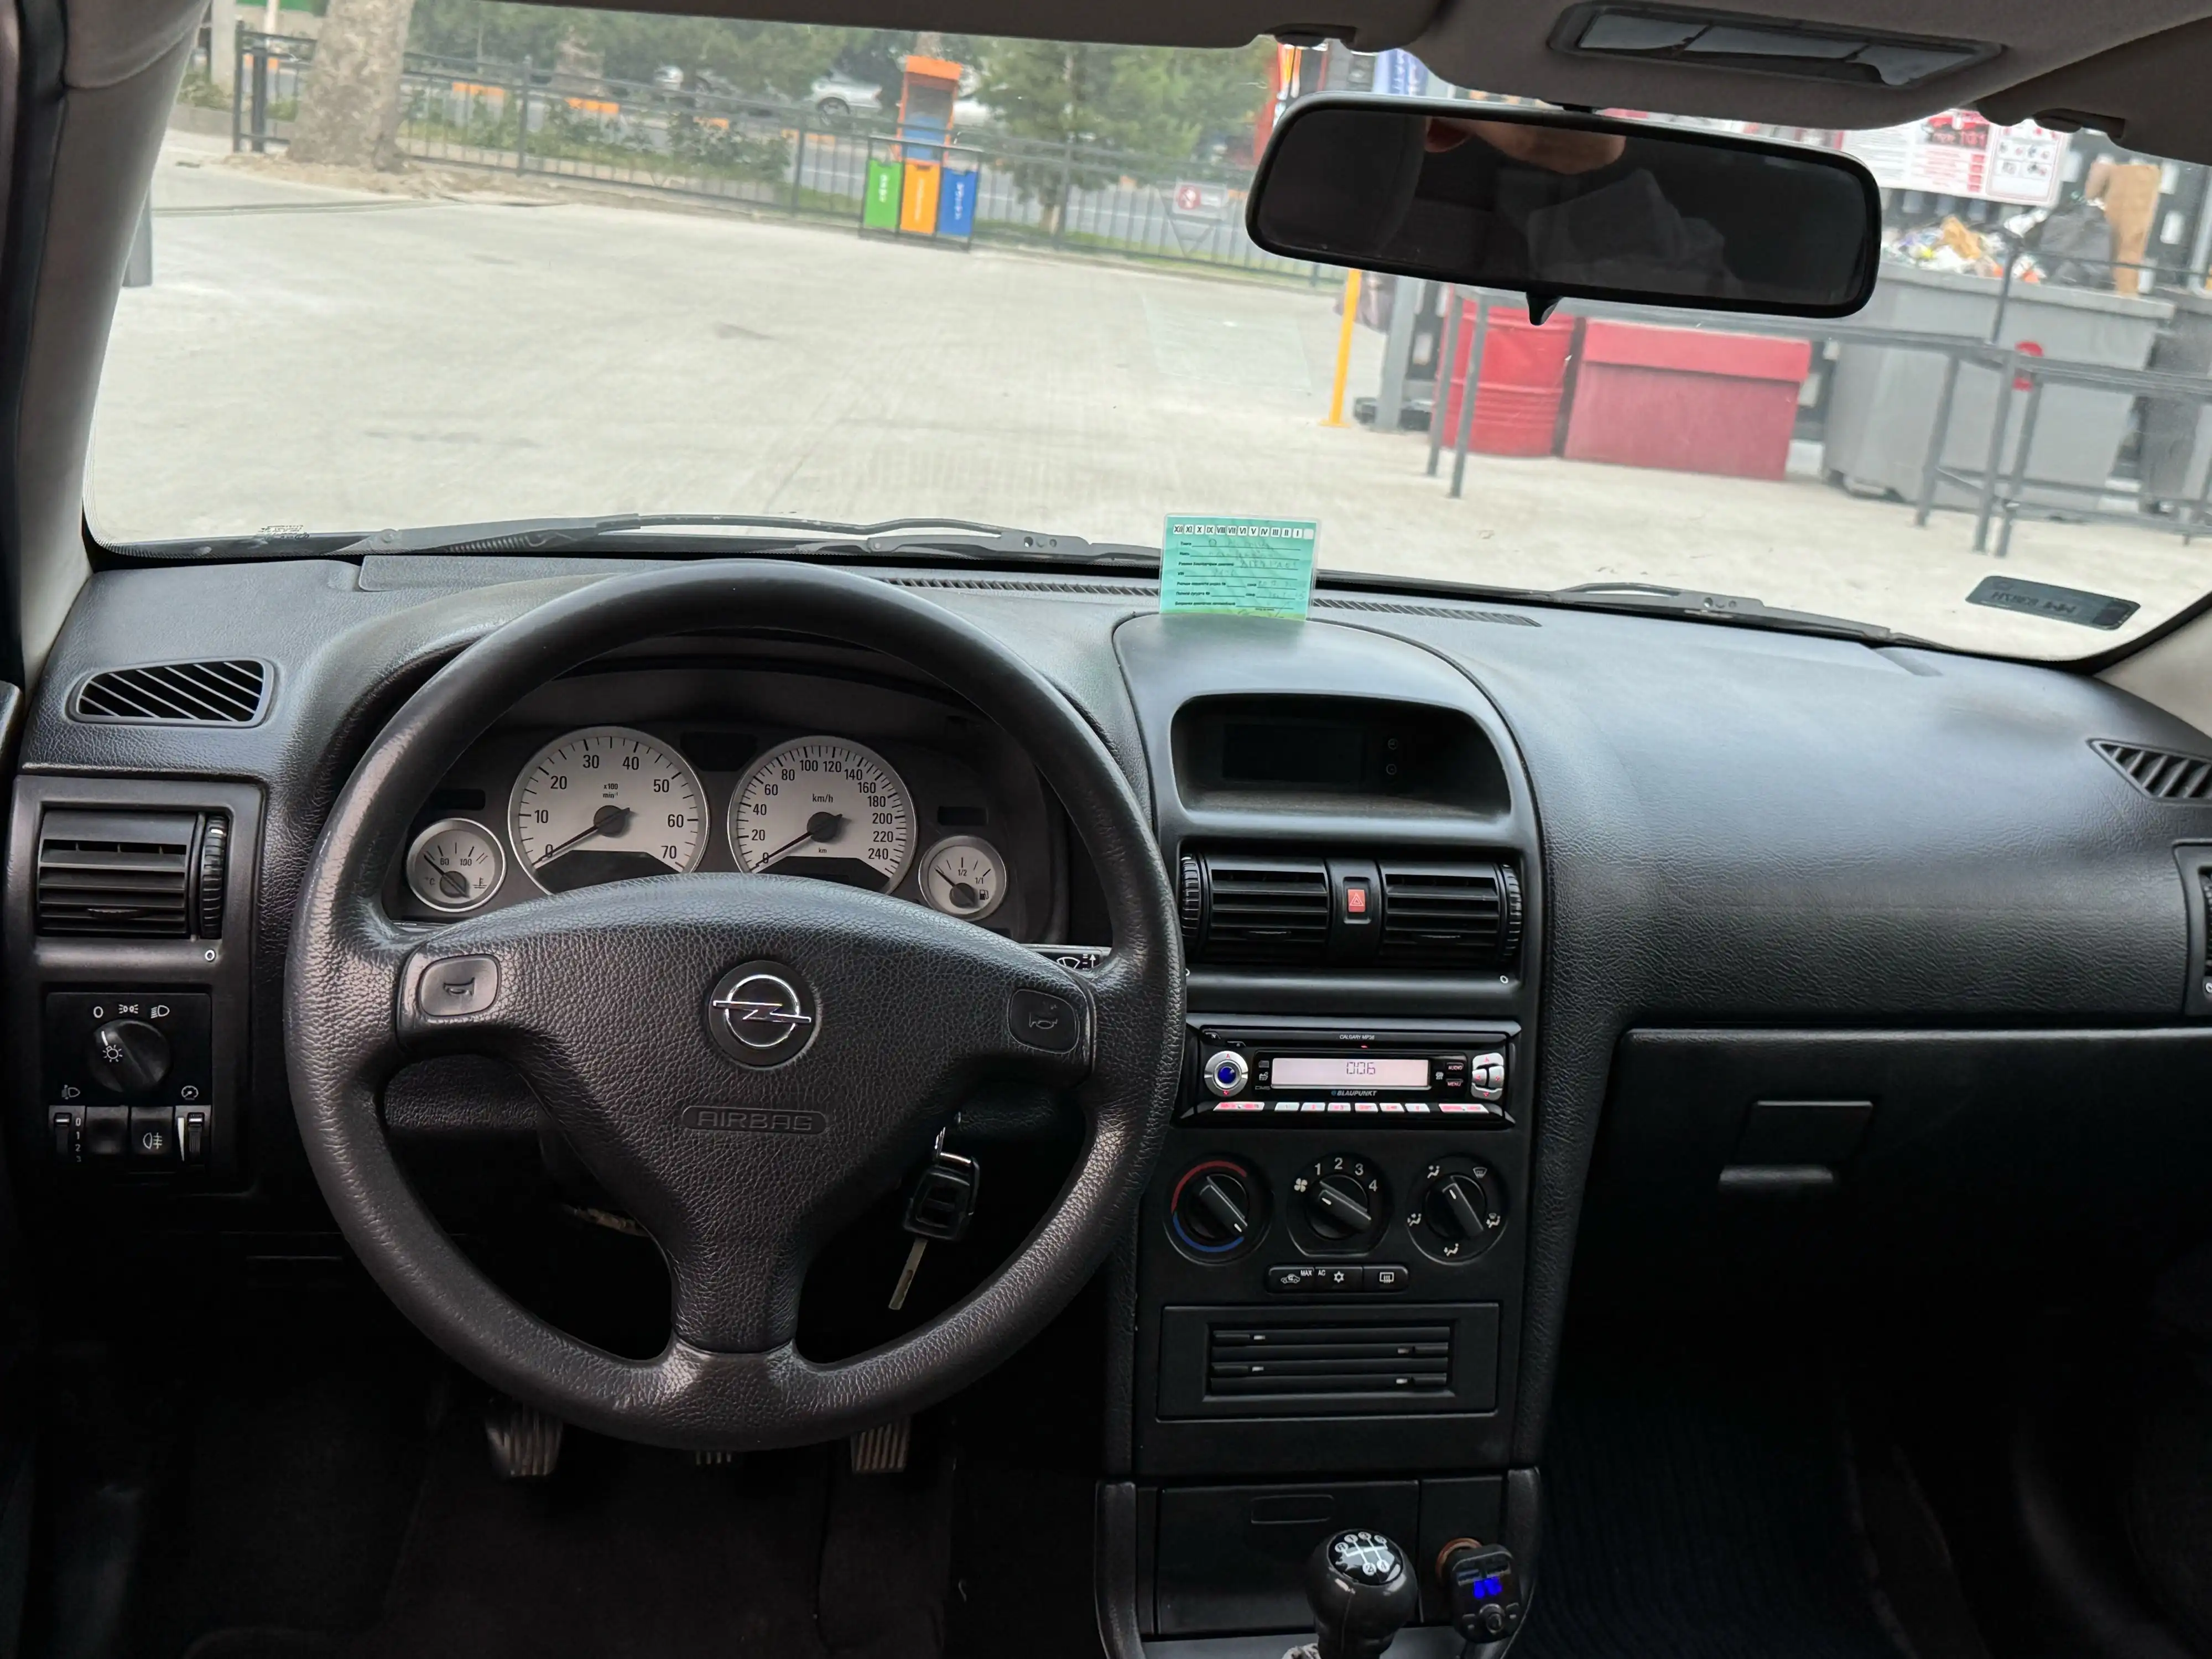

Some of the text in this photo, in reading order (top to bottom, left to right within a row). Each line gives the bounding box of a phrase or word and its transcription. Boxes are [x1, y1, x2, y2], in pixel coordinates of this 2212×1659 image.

[582, 755, 600, 769] 30
[622, 756, 639, 771] 40
[800, 760, 818, 772] 100
[823, 761, 842, 773] 120
[781, 768, 795, 781] 80
[845, 769, 863, 781] 140
[550, 775, 568, 790] 20
[653, 779, 670, 793] 50
[858, 782, 876, 794] 160
[764, 783, 778, 796] 60
[812, 793, 834, 803] km/h
[867, 795, 886, 808] 180
[753, 803, 767, 816] 40
[534, 809, 549, 824] 10
[667, 814, 684, 828] 60
[872, 812, 893, 825] 200
[751, 829, 766, 841] 20
[873, 830, 893, 842] 220
[661, 845, 677, 859] 70
[868, 847, 889, 860] 240
[460, 858, 472, 866] 100
[75, 1117, 81, 1126] 0
[697, 1110, 813, 1131] AIRBAG
[76, 1131, 80, 1140] 1
[75, 1143, 81, 1152] 2
[1314, 1163, 1322, 1175] 1
[1334, 1157, 1343, 1170] 2
[1355, 1163, 1364, 1176] 3
[1368, 1179, 1377, 1192] 4
